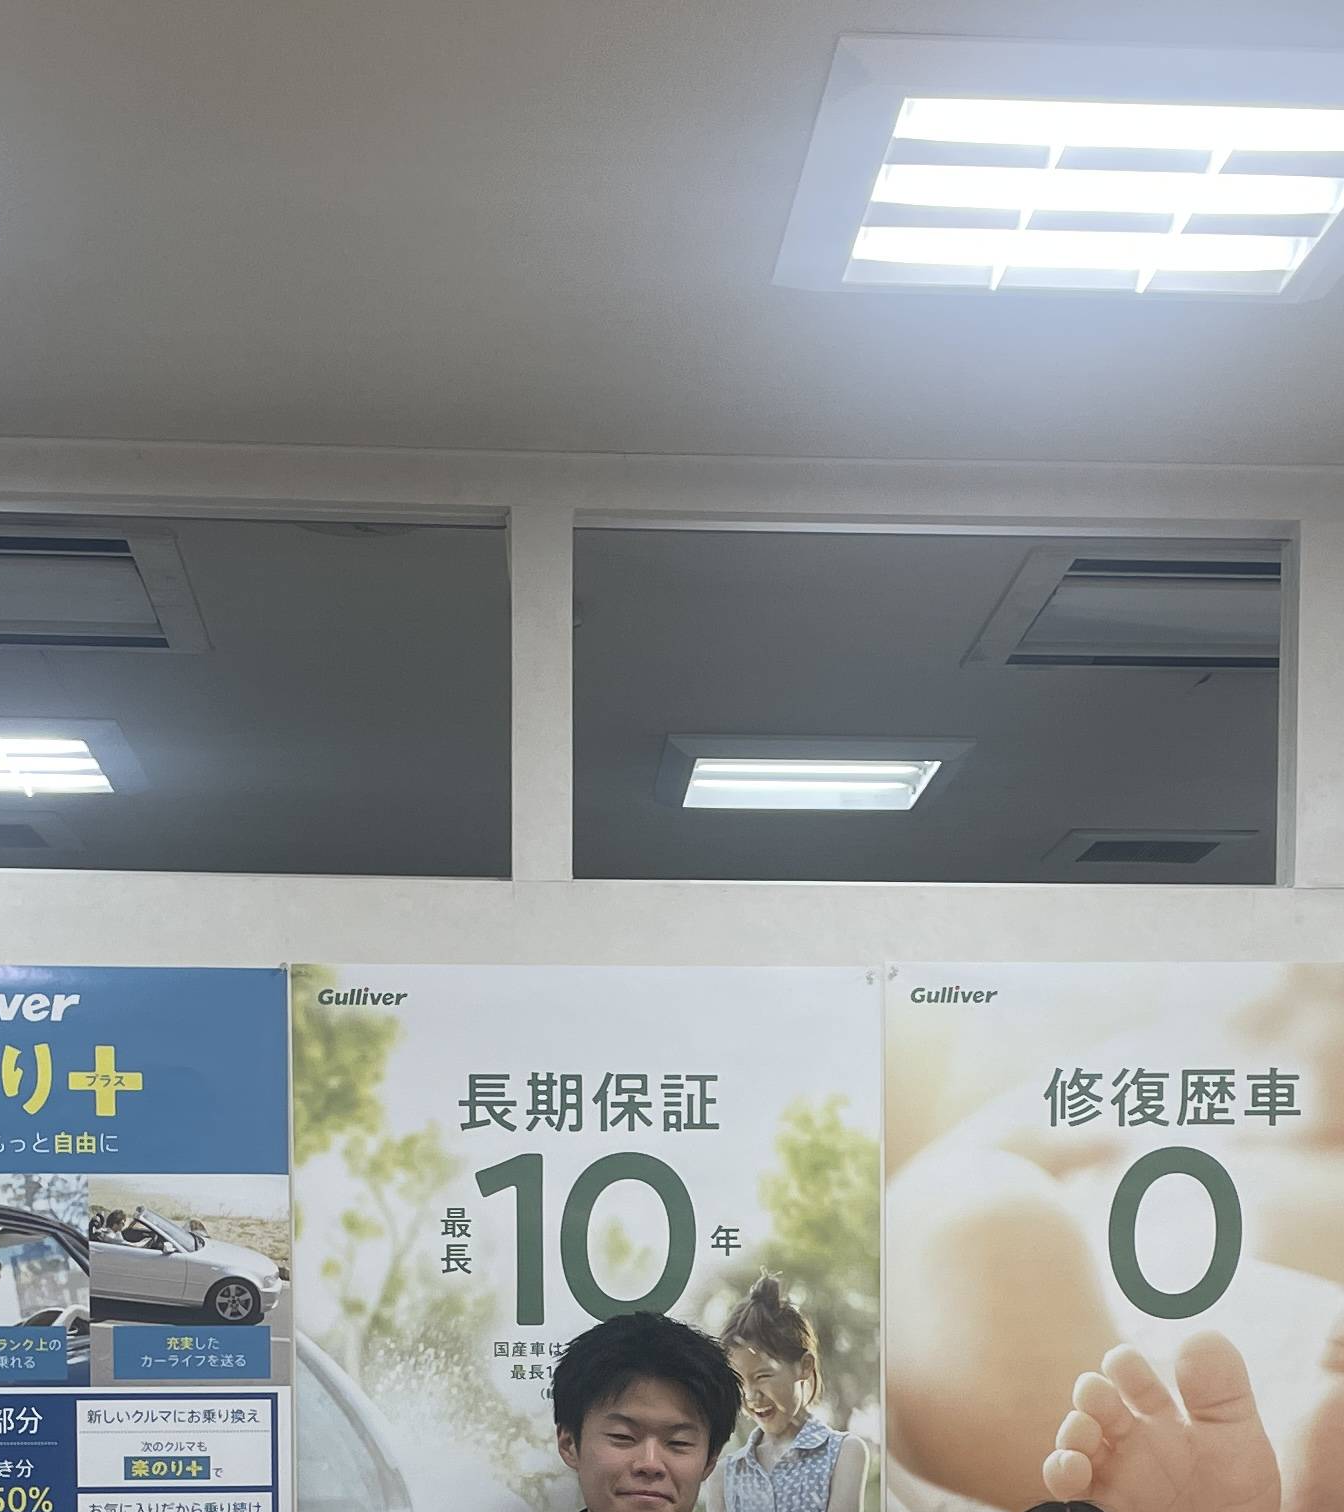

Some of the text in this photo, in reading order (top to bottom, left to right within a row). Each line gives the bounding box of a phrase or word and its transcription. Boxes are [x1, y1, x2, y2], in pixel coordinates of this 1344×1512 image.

[317, 987, 408, 1006] Gulliver
[910, 986, 999, 1005] Gulliver
[85, 1074, 126, 1088] プラス
[457, 1071, 720, 1133] 長期保証
[1043, 1067, 1302, 1127] 修復歴車
[440, 1152, 742, 1326] 最長 10 年
[1108, 1146, 1243, 1320] 0
[166, 1336, 220, 1351] 充実した
[140, 1354, 247, 1368] カーライフを送る
[87, 1408, 260, 1424] 新しいクルマにお乗り換え
[141, 1441, 208, 1452] 次のクルマも
